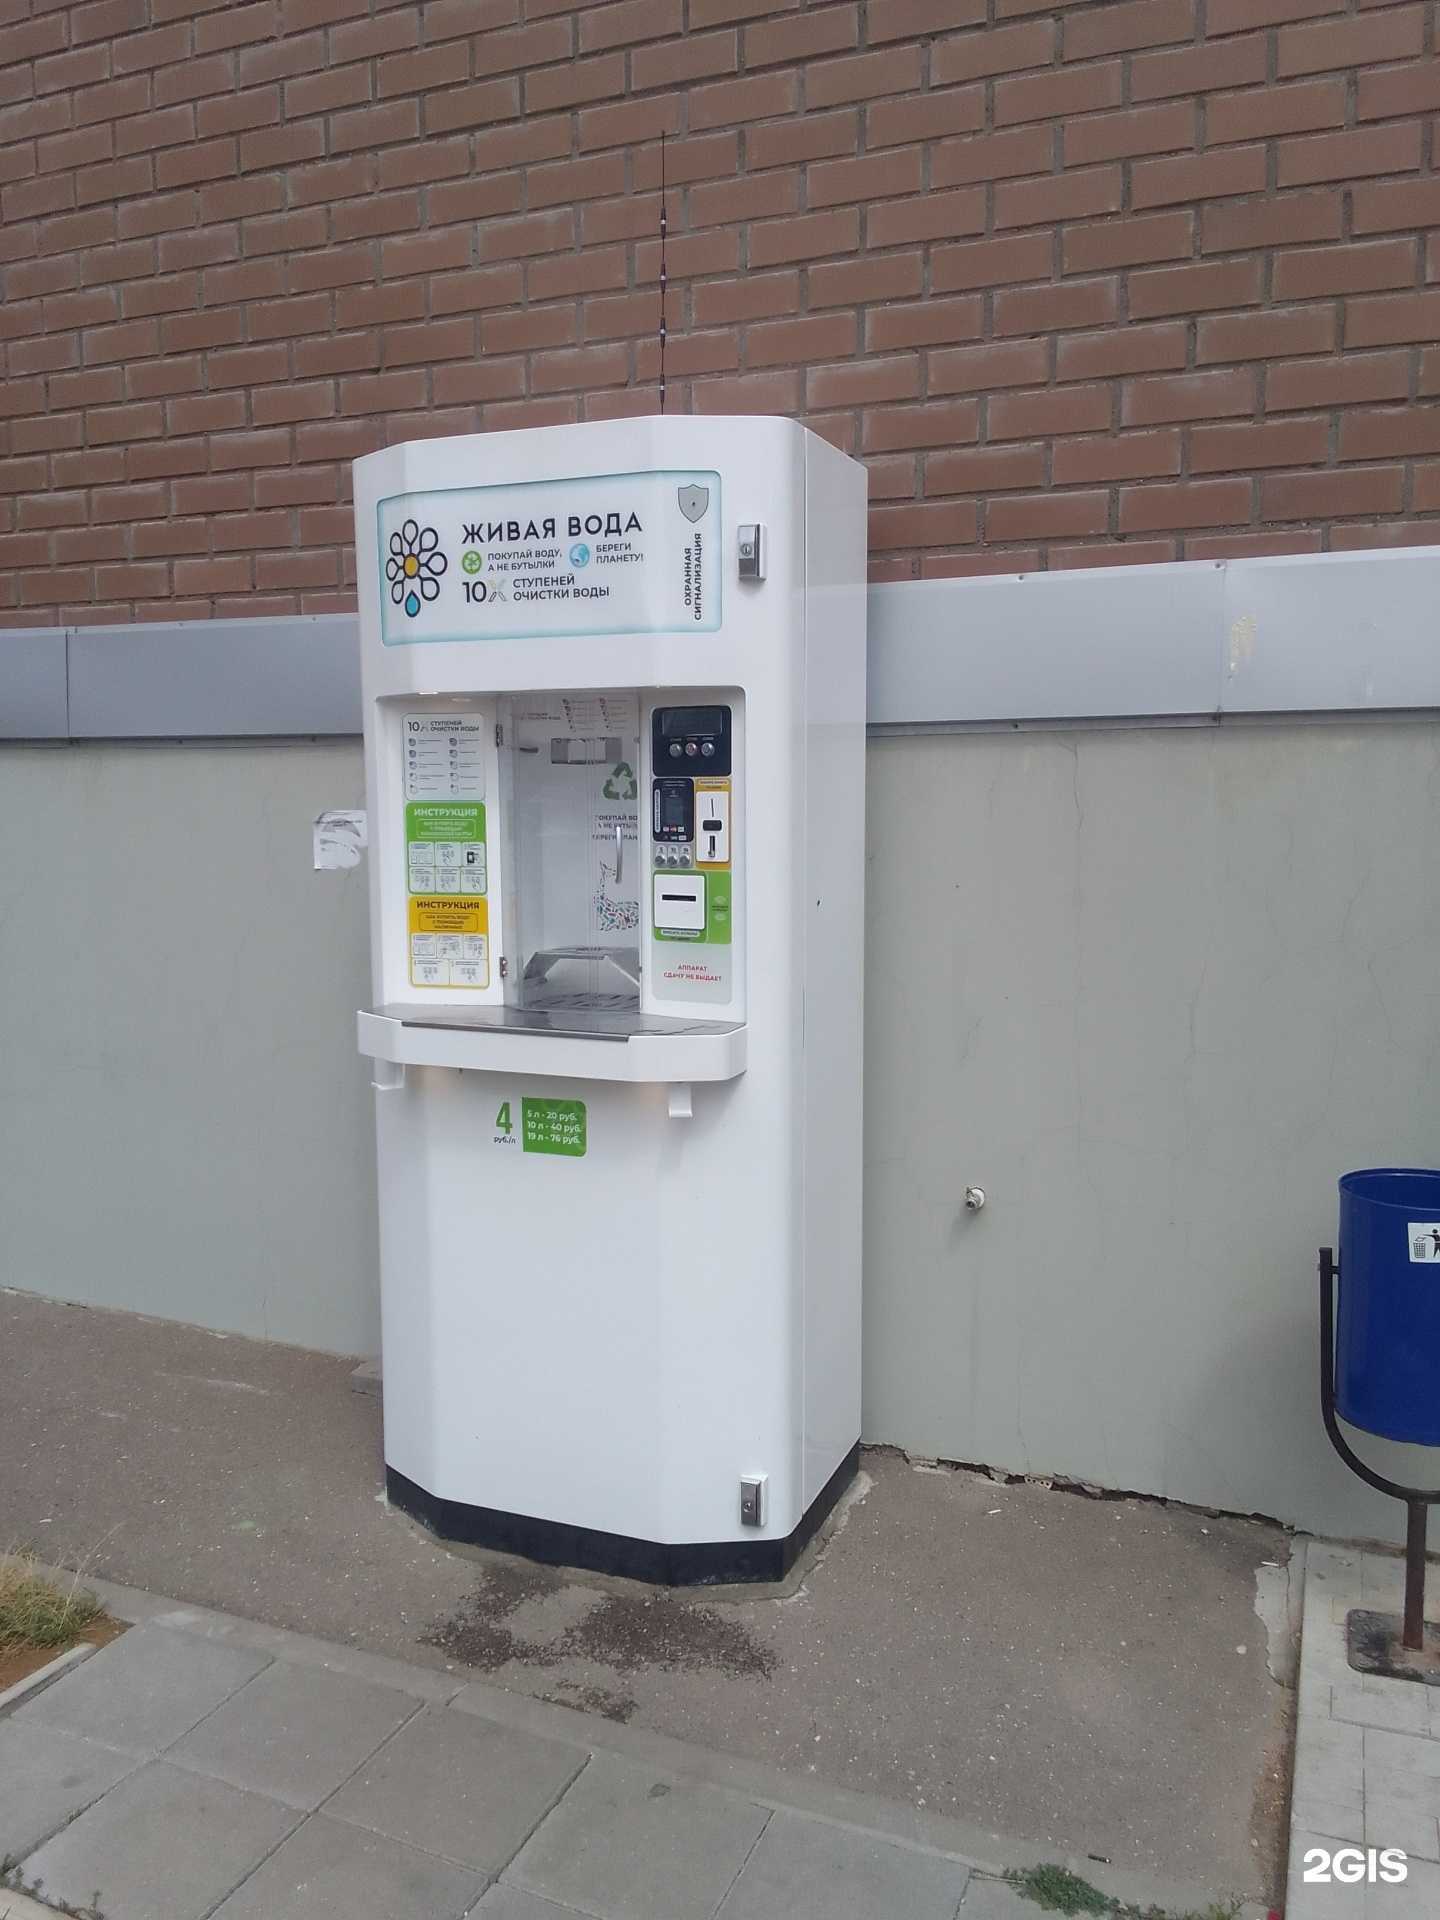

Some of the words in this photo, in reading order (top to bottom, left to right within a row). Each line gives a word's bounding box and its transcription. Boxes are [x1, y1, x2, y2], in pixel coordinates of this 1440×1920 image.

[461, 518, 556, 544] ЖИВАЯ
[568, 512, 642, 538] ВОДА
[596, 543, 632, 553] БЕРЕГИ
[488, 549, 532, 561] ПОКУПАЙ
[596, 553, 644, 564] ПЛАНЕТУ!
[497, 563, 509, 571] НЕ
[511, 560, 555, 571] БУТЫЛКИ
[513, 573, 575, 588] СТУПЕНЕЙ
[684, 547, 692, 606] ОХРАННАЯ
[694, 533, 702, 620] СИГНАЛИЗАЦИЯ
[513, 589, 569, 601] ОЧИСТКИ
[573, 587, 609, 599] ВОДЫ
[416, 901, 480, 910] ИНСТРУКЦИЯ
[678, 964, 708, 972] АППАРАТ
[496, 1102, 513, 1134] 4
[527, 1110, 532, 1118] 5
[546, 1111, 558, 1120] 20
[559, 1112, 577, 1122] руб.
[527, 1121, 536, 1129] 10
[537, 1122, 544, 1130] л
[550, 1123, 562, 1131] 40
[563, 1124, 581, 1133] руб.
[562, 1134, 581, 1145] руб.
